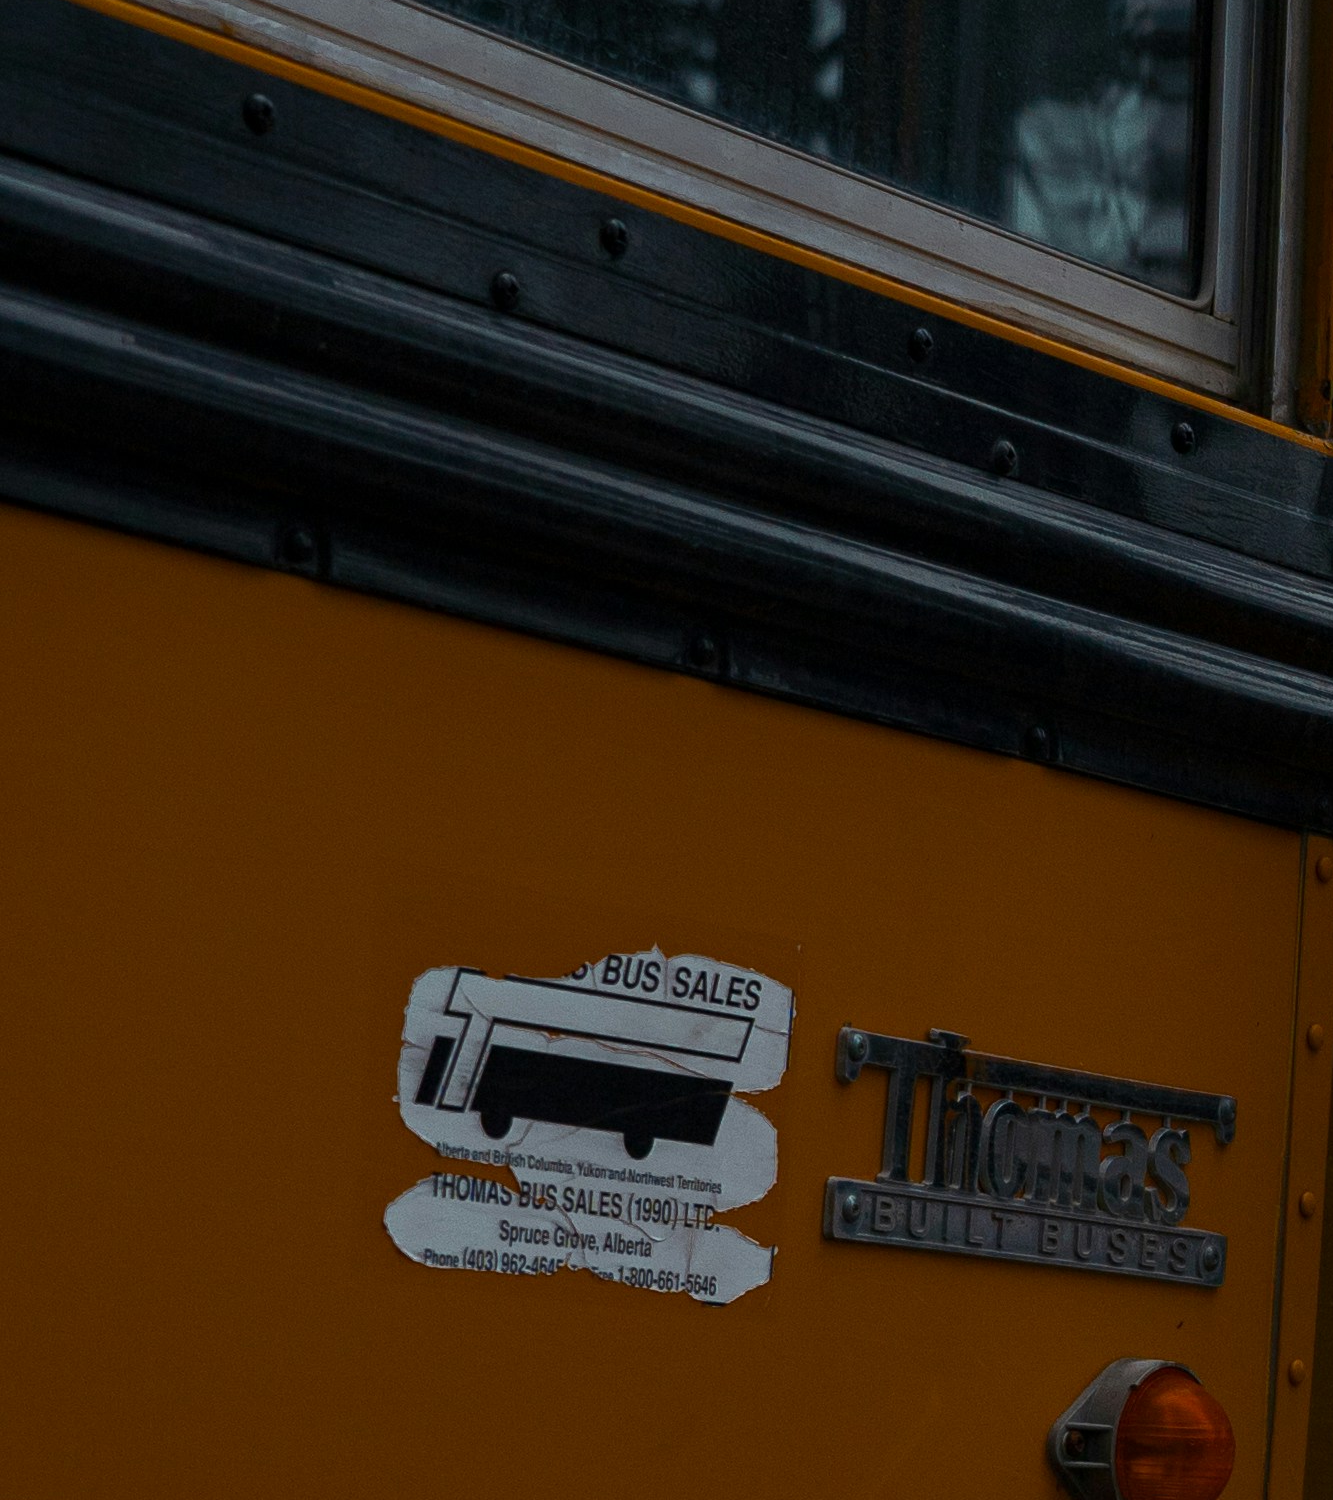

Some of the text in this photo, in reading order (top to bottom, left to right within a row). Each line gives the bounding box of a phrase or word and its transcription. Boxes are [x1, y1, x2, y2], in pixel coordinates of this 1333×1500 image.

[602, 954, 661, 992] BUS
[672, 966, 762, 1011] SALES
[837, 1027, 1236, 1226] Thomas
[471, 1149, 490, 1162] and
[493, 1149, 526, 1168] British
[577, 1162, 607, 1179] Yukon
[607, 1167, 627, 1182] and
[628, 1168, 675, 1189] Northwest
[677, 1174, 722, 1195] Territories
[432, 1172, 720, 1232] THOMAS BUS SALES (1990) LTD.
[499, 1219, 652, 1258] Spruce Grove, Alberta
[869, 1196, 1194, 1274] BUILT BUSES
[424, 1248, 460, 1267] Phone
[463, 1246, 498, 1271] (403)
[618, 1265, 717, 1296] 1-800-661-5646
